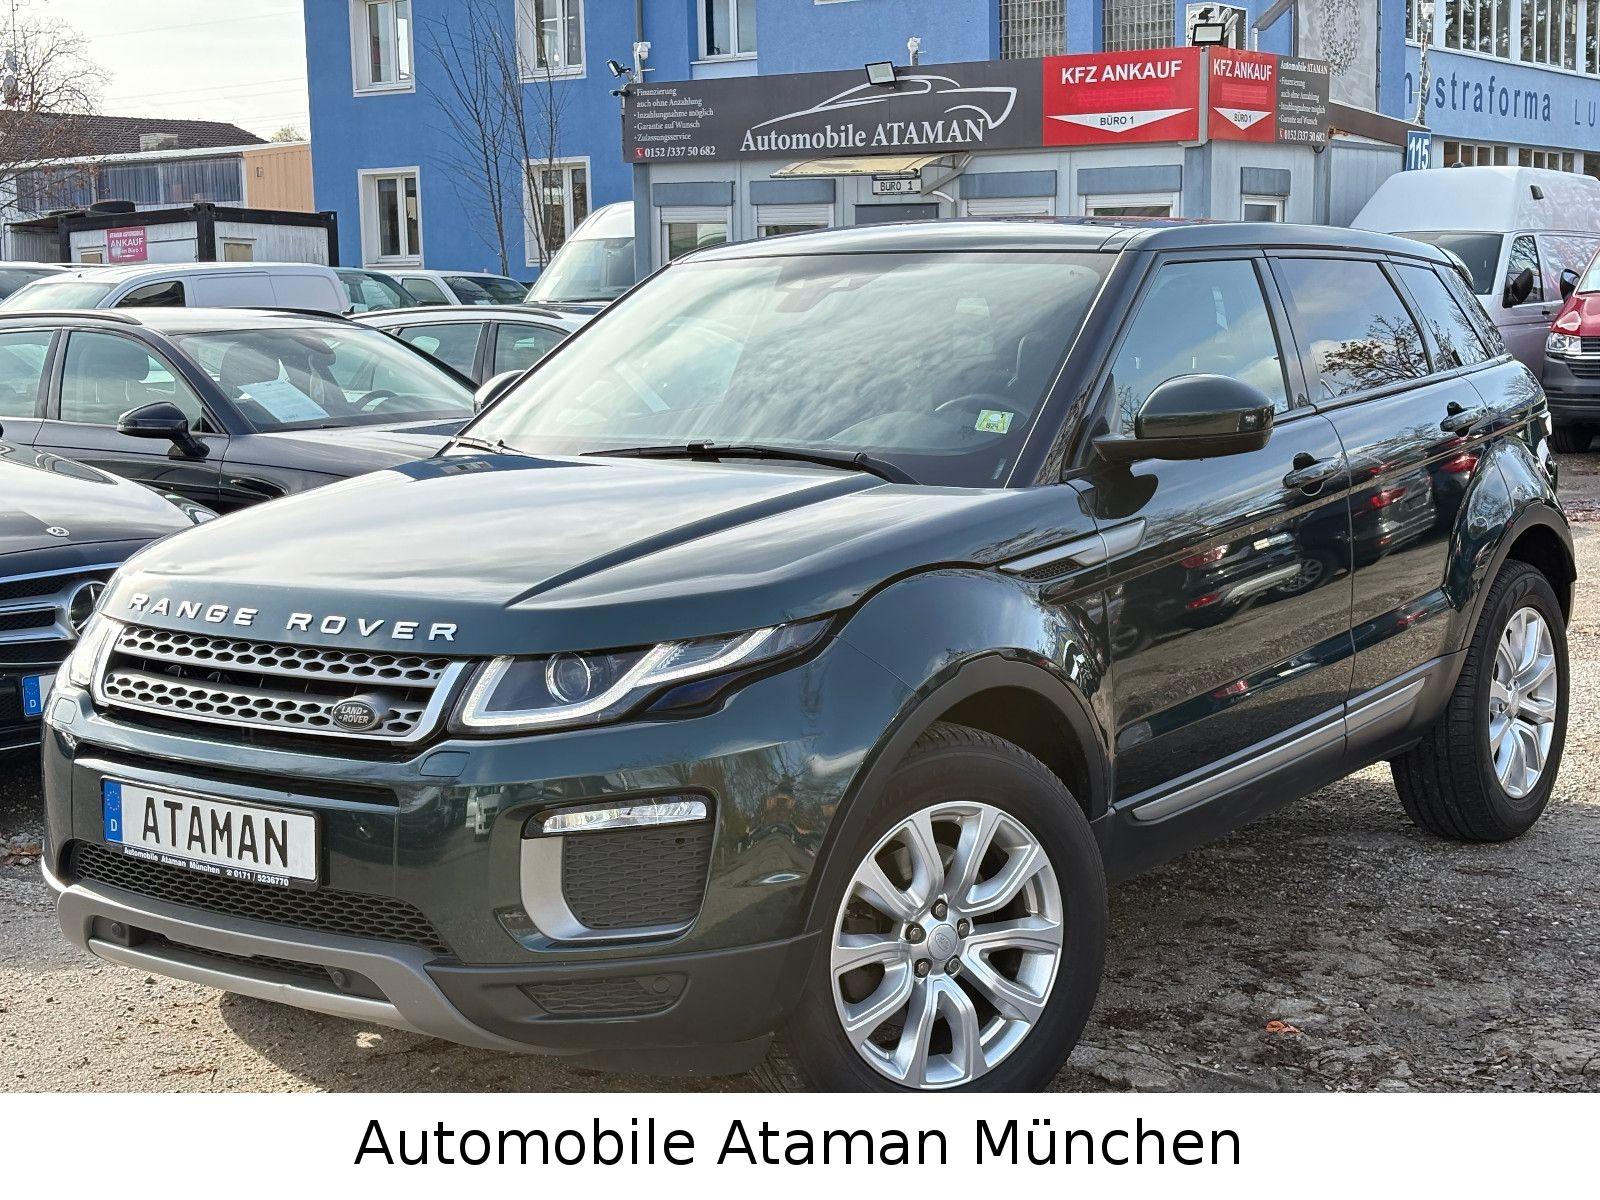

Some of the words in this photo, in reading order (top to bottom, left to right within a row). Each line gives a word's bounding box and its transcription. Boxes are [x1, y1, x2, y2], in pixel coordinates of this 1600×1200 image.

[1062, 66, 1098, 84] KFZ
[1101, 60, 1182, 82] ANKAUF
[1214, 58, 1233, 77] KFZ
[1234, 60, 1273, 81] ANKAUF
[1307, 63, 1328, 74] ATAMAN
[637, 88, 677, 96] Finanzierung
[637, 99, 651, 108] auch
[653, 99, 667, 107] ohne
[670, 98, 702, 107] Anzahlung
[689, 108, 714, 118] möglich
[1234, 112, 1248, 122] BÜRO
[1249, 114, 1252, 123] 1
[665, 121, 675, 129] auf
[676, 120, 700, 128] Wunsch
[1100, 115, 1127, 126] BÜRO
[1130, 116, 1134, 125] 1
[638, 134, 691, 142] Zulassungsservice
[740, 124, 866, 151] Automobile
[871, 119, 985, 146] ATAMAN
[688, 147, 698, 156] 50
[700, 146, 716, 156] 682
[1409, 136, 1429, 170] 115
[880, 180, 902, 192] BÜRO
[908, 181, 913, 190] 1
[111, 238, 143, 247] ANKAUF
[127, 593, 258, 626] RANGE
[286, 613, 459, 642] ROVER
[30, 700, 36, 708] D
[341, 706, 362, 714] LAND
[342, 715, 369, 724] ROVER
[111, 819, 118, 832] D
[142, 797, 288, 868] ATAMAN
[124, 847, 158, 862] Automobile
[162, 856, 186, 868] Ataman
[190, 862, 220, 874] München
[234, 870, 251, 880] 0171
[258, 873, 289, 886] 5236770
